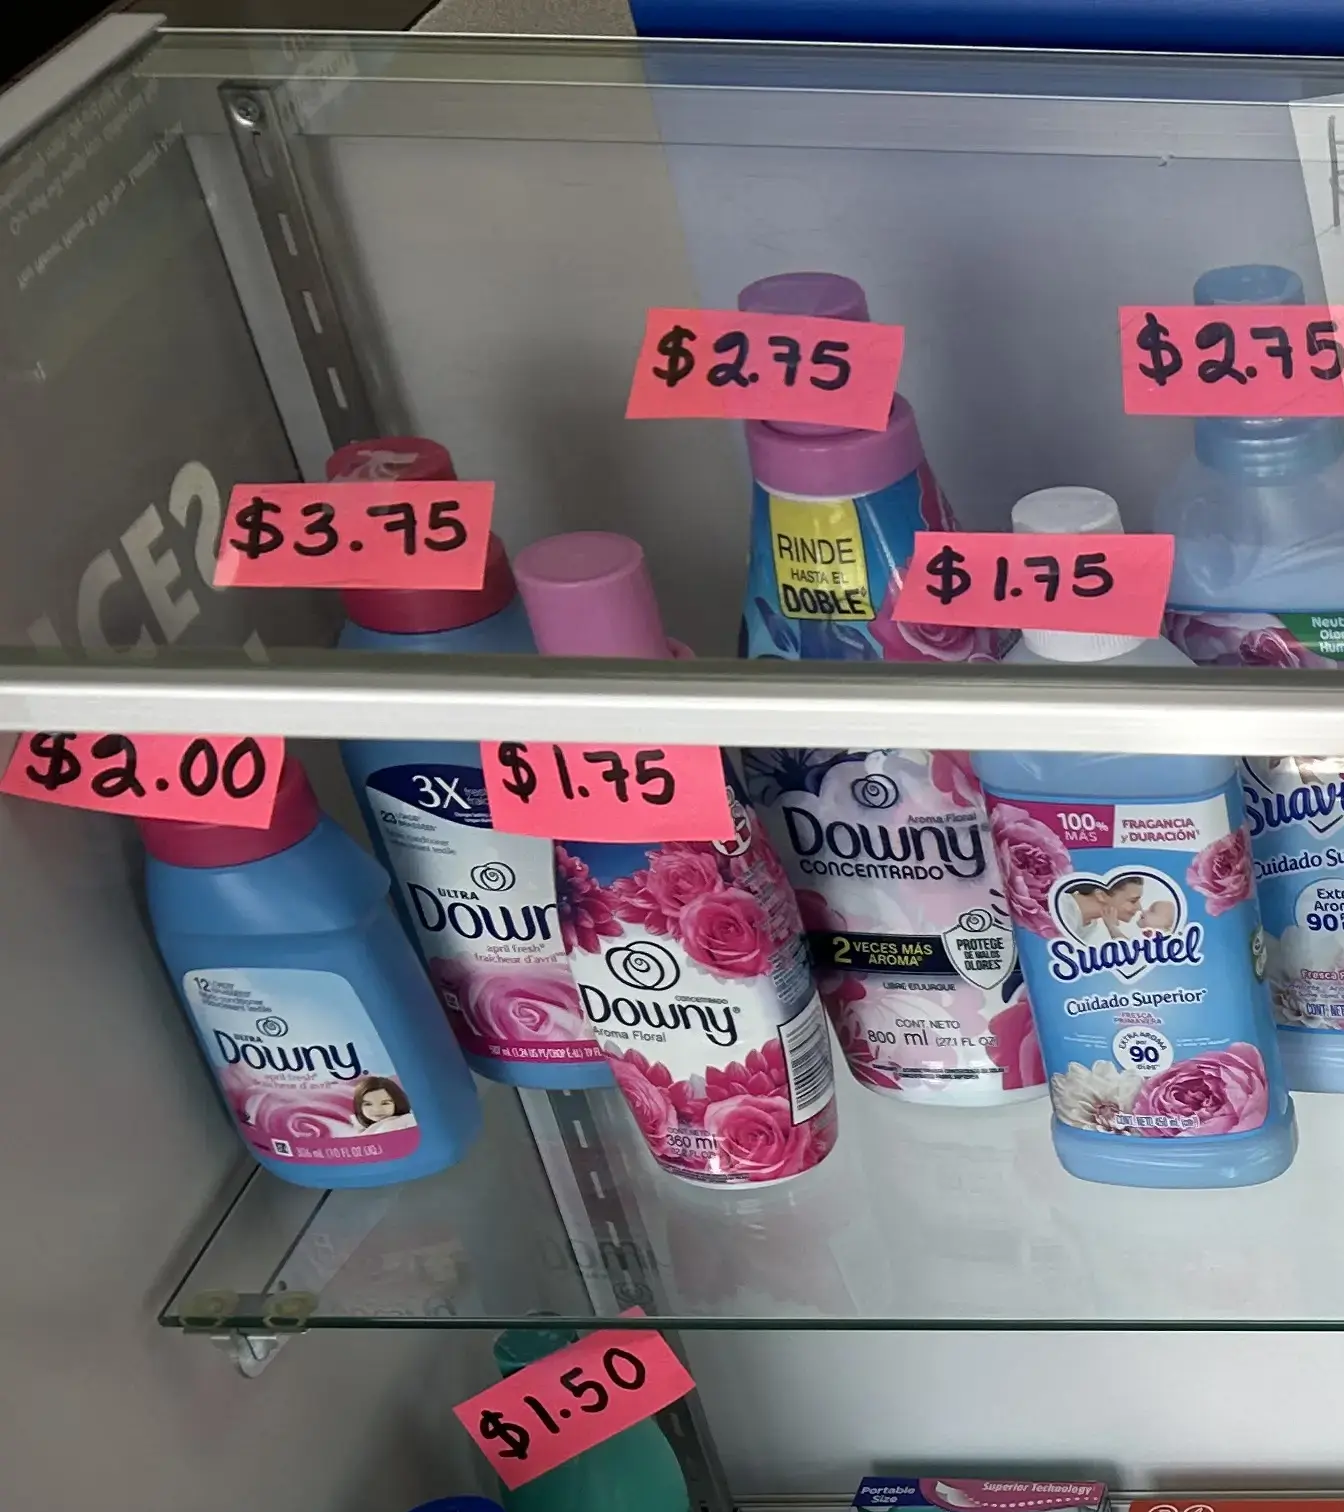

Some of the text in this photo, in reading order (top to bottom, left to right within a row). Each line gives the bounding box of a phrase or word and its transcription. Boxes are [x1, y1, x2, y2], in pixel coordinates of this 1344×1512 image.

[652, 325, 851, 390] $2.75
[230, 497, 467, 558] $3.75
[778, 532, 855, 564] RINDE
[791, 568, 848, 584] HASTA EL
[926, 545, 1114, 604] $1.75
[782, 584, 866, 617] DOBLE
[26, 732, 267, 799] $2.00
[497, 741, 675, 805] $1.75
[412, 775, 471, 810] 3X
[1122, 818, 1195, 830] FRAGANCIA
[782, 806, 986, 878] Downy
[800, 859, 943, 880] CONCENTRADO
[1307, 914, 1338, 930] 90
[853, 942, 898, 953] VECES
[1052, 925, 1202, 982] Suavitel
[578, 983, 738, 1047] Downy
[1067, 993, 1130, 1016] Cuidado
[213, 1029, 362, 1080] Downy
[1129, 1045, 1160, 1065] 90
[480, 1347, 646, 1460] $1.50
[861, 1482, 1092, 1496] Portable Superior Technology
